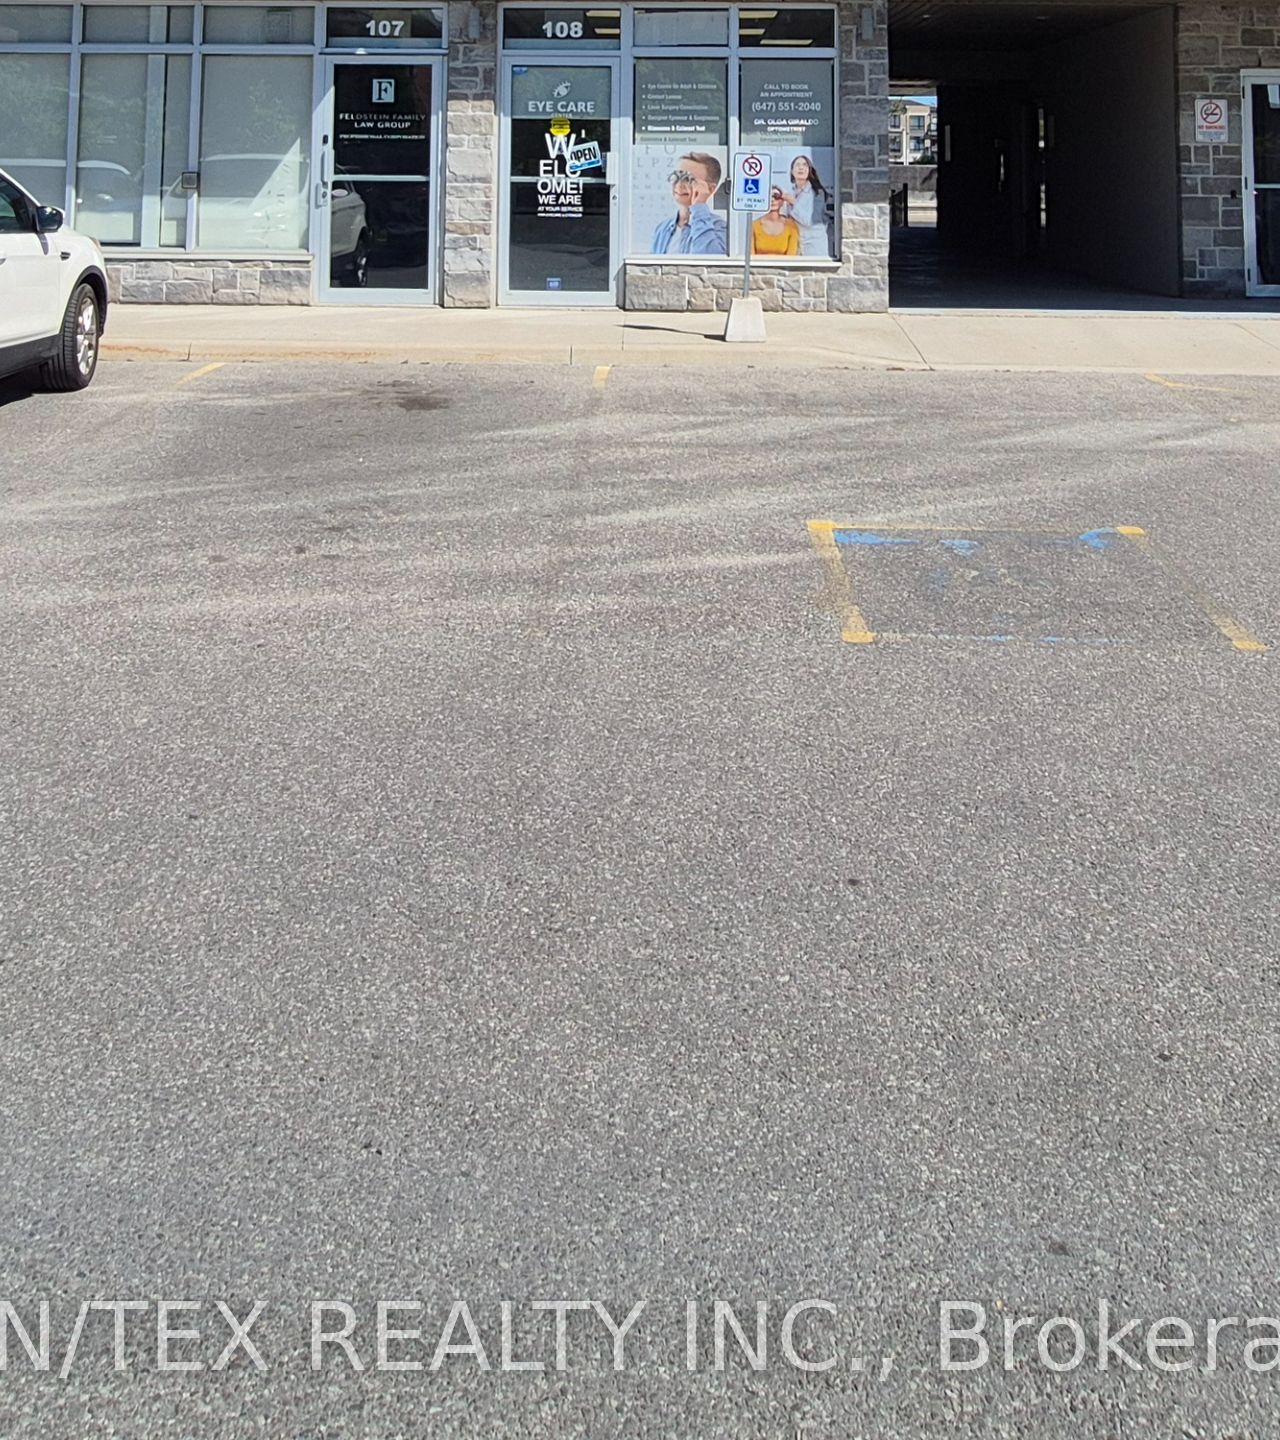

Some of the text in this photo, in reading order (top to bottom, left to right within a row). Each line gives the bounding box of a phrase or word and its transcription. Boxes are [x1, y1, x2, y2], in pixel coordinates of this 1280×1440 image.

[365, 20, 405, 36] 107
[542, 21, 584, 38] 108
[375, 80, 393, 101] F
[528, 101, 595, 113] EYE CARE
[751, 102, 821, 112] (647) 551-2040
[392, 113, 426, 121] FAMILY
[570, 146, 597, 162] OPEN
[537, 180, 584, 194] OME!
[537, 194, 582, 205] WE ARE
